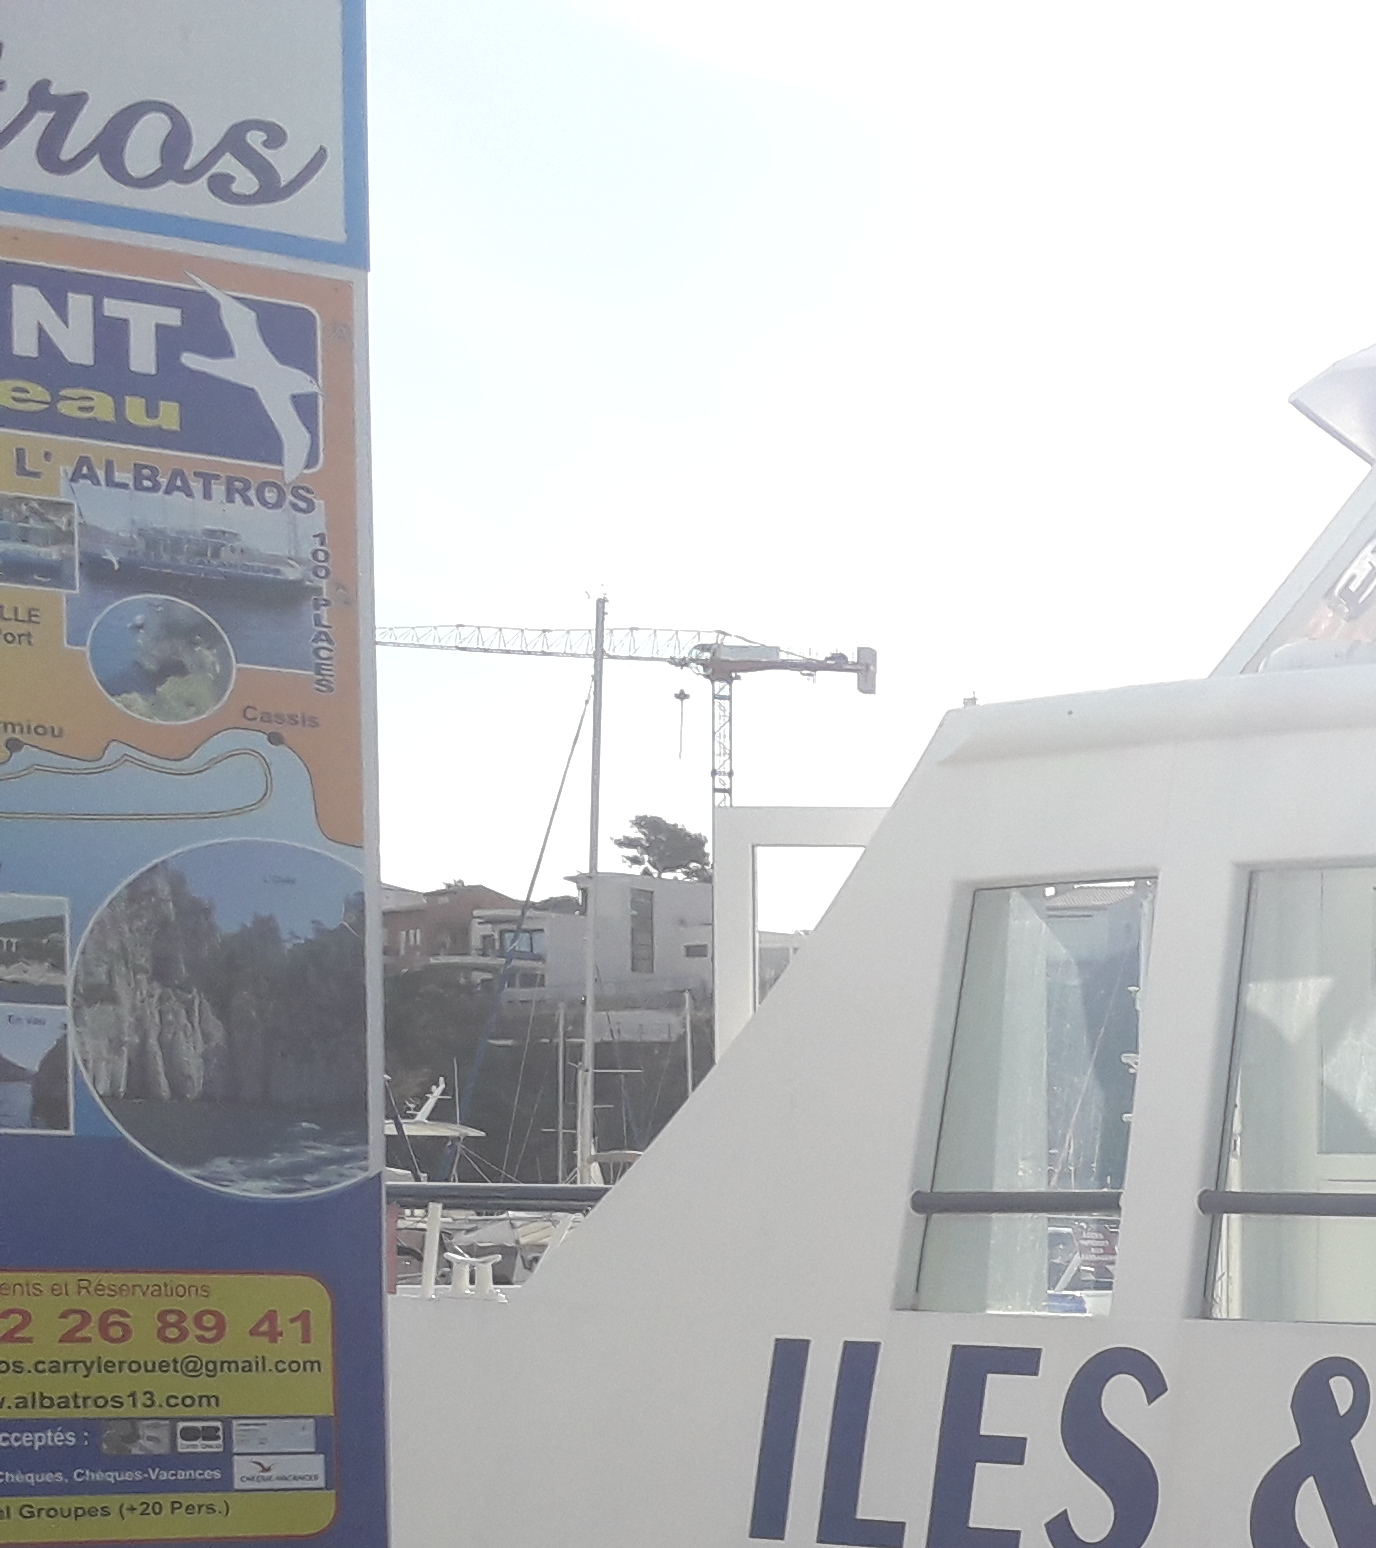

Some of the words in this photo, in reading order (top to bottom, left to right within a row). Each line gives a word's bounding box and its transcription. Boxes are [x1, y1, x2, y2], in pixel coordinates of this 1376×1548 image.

[69, 454, 317, 515] ALBATROS
[312, 532, 332, 579] 100
[311, 597, 335, 693] PLACES
[243, 706, 320, 729] Cassis
[51, 1281, 69, 1297] et
[77, 1277, 210, 1299] Réservations
[58, 1307, 134, 1344] 26
[156, 1308, 228, 1345] 89
[249, 1308, 313, 1345] 41
[19, 1503, 112, 1521] Groupes
[119, 1501, 163, 1521] (+20
[170, 1500, 231, 1518] Pers.)
